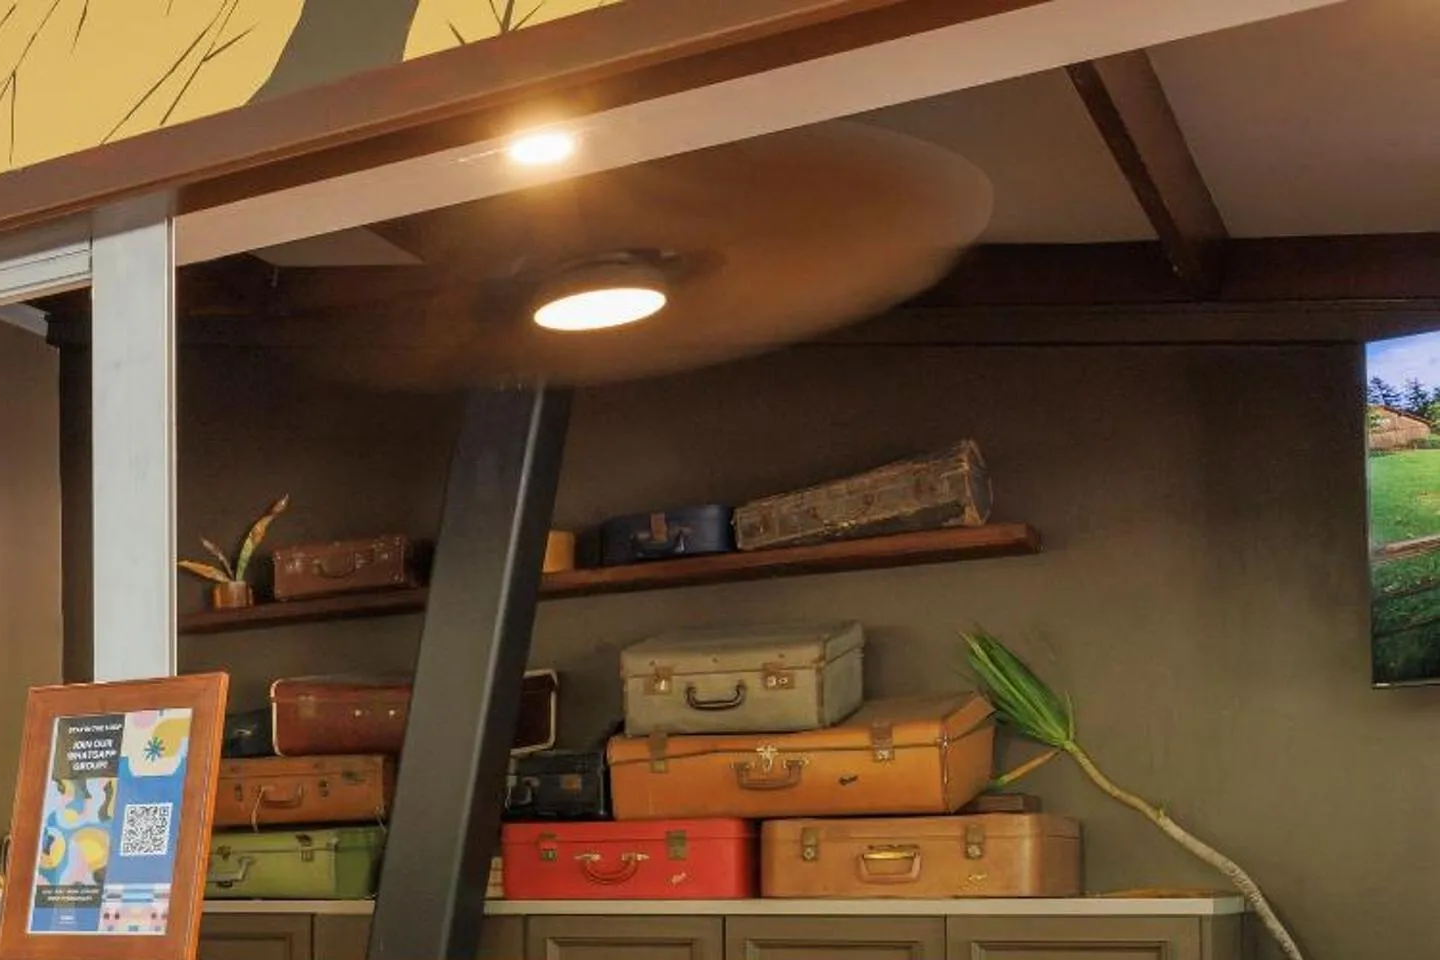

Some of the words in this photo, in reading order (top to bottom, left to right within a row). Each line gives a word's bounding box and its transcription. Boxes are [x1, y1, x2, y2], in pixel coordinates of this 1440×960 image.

[73, 740, 92, 750] JOIN
[93, 739, 113, 748] OUR
[67, 750, 117, 760] WHATSAPP
